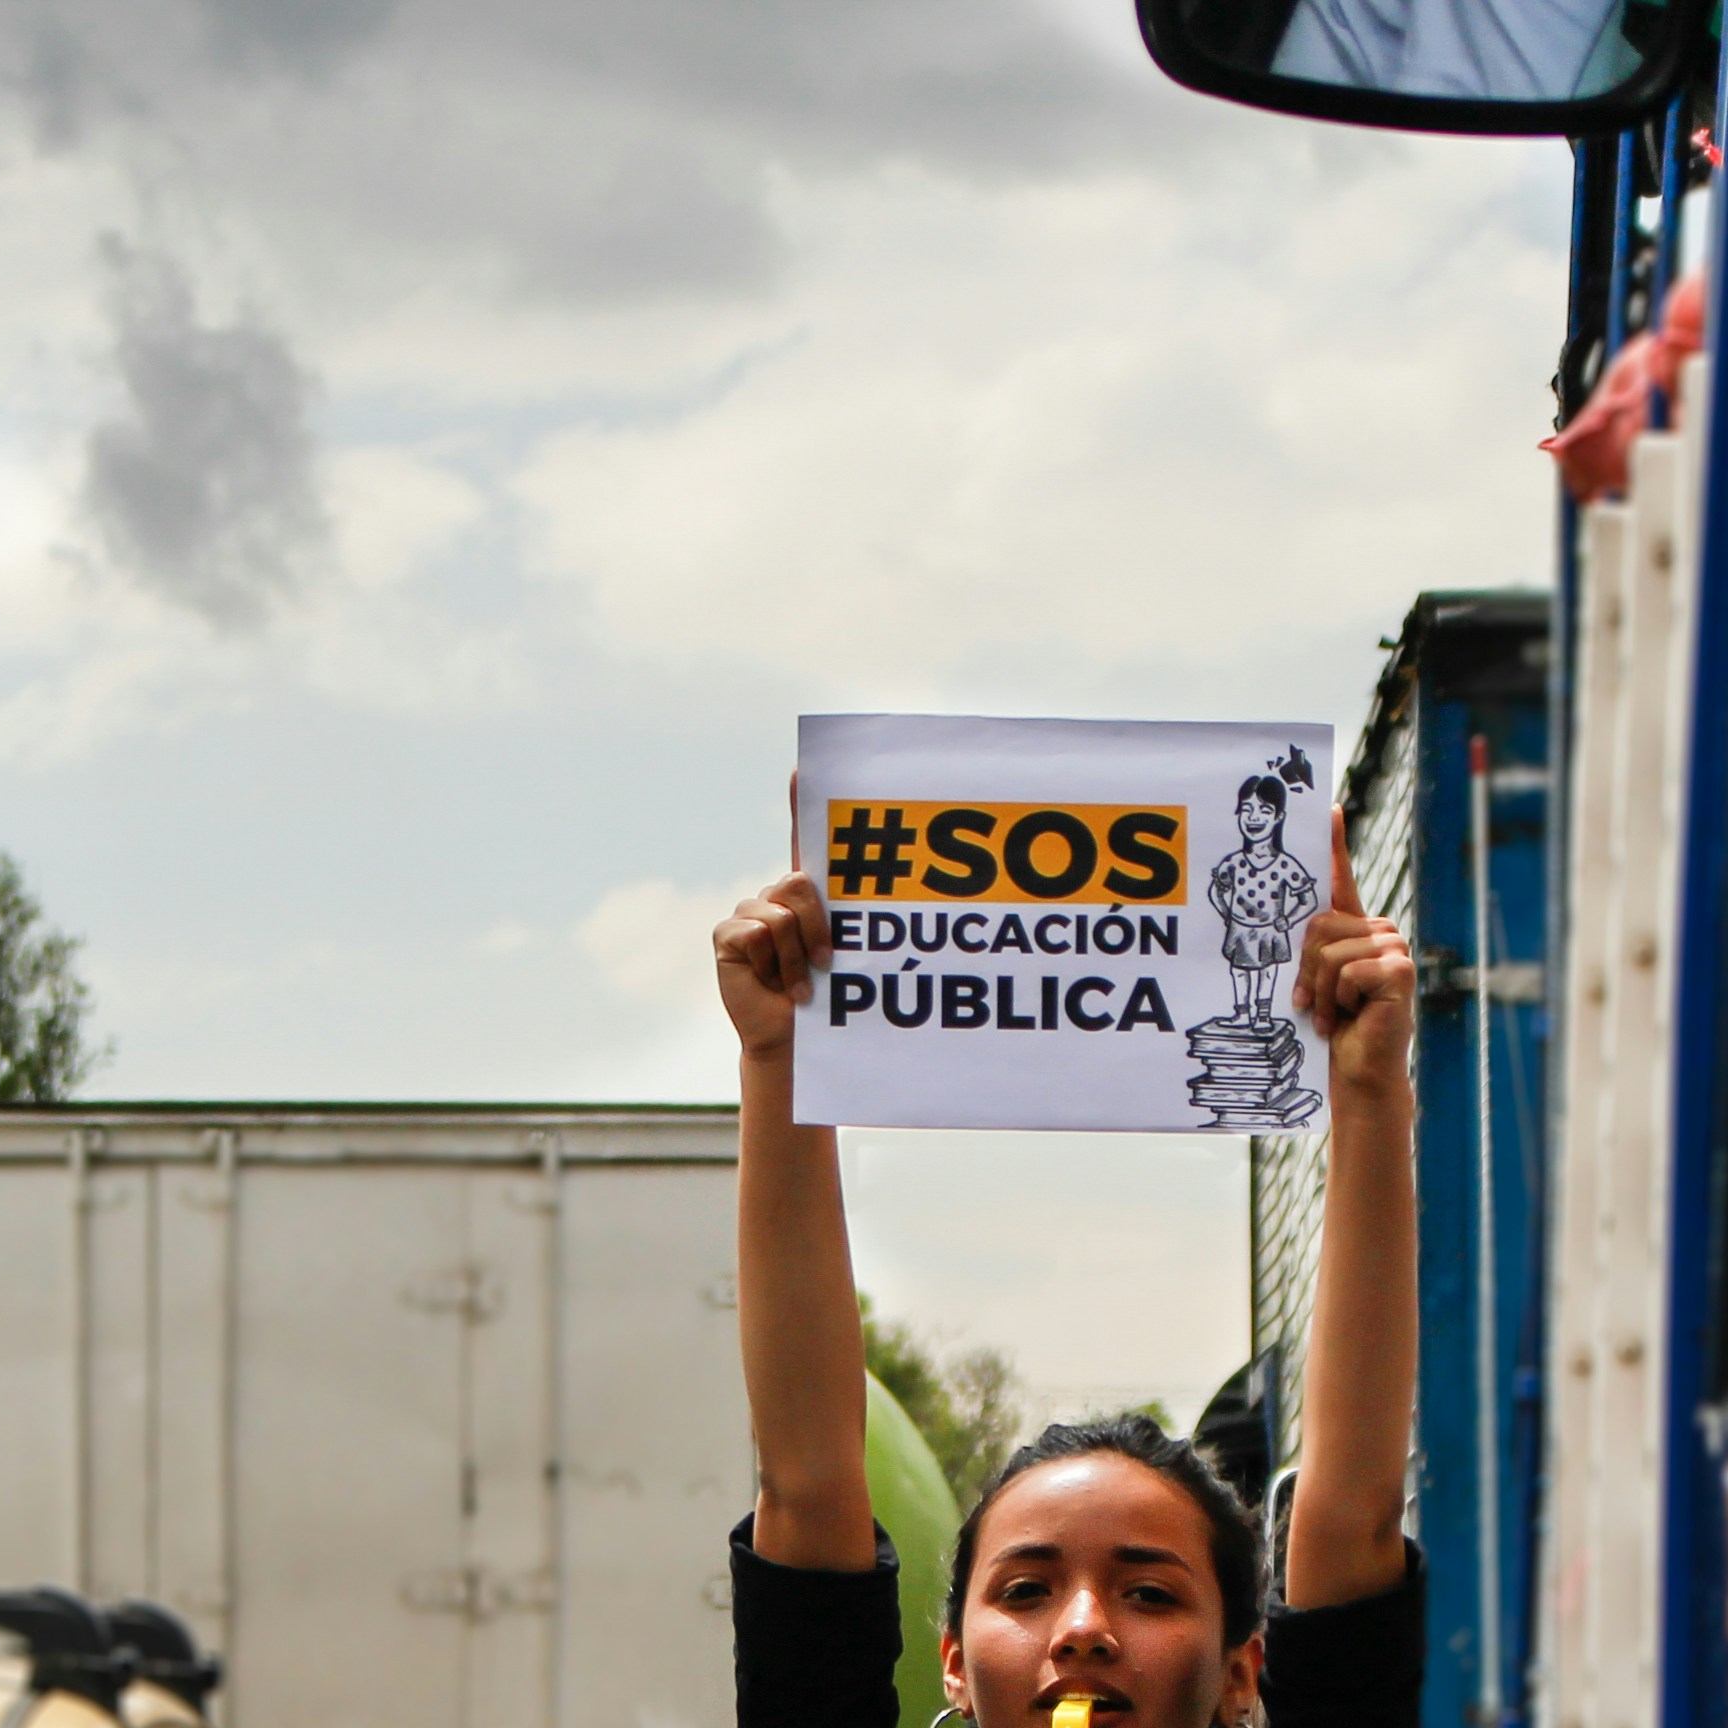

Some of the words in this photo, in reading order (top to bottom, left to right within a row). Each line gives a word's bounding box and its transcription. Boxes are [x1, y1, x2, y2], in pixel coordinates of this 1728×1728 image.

[828, 808, 1180, 901] #SOS
[830, 902, 1178, 956] EDUCACIÓN
[829, 957, 1176, 1032] PÚBLICA
